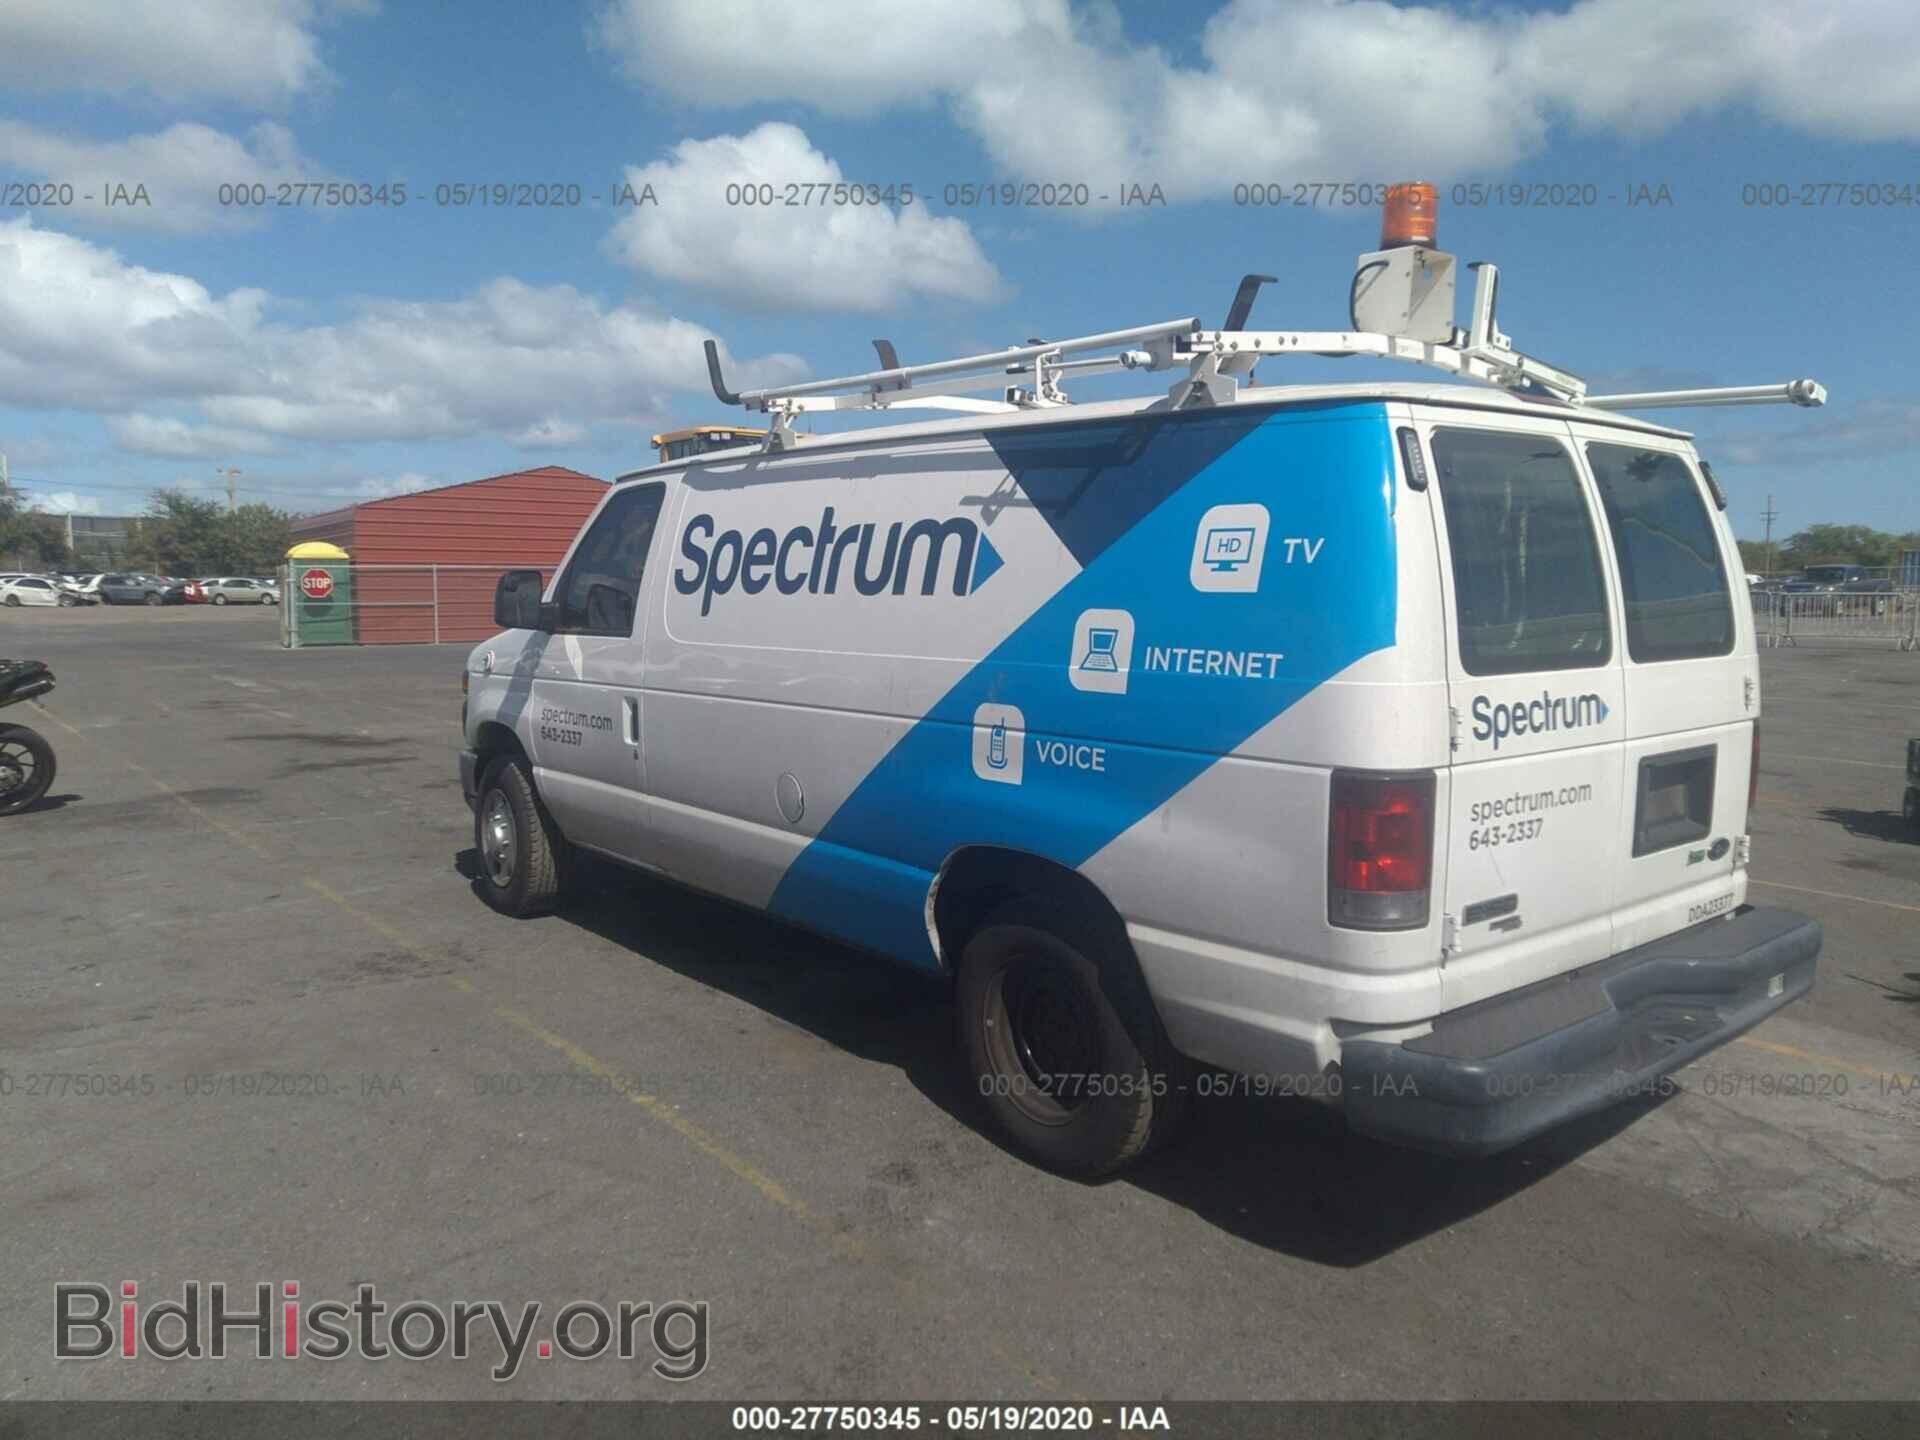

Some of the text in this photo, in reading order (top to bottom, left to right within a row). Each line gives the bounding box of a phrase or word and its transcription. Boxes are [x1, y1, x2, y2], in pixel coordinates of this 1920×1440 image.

[1217, 537, 1242, 553] HD
[1283, 537, 1326, 564] TV
[674, 506, 978, 617] Spectrum
[303, 577, 331, 589] STOP
[1144, 646, 1284, 680] INTERNET
[541, 707, 614, 731] spectrum.com
[1472, 690, 1601, 750] Spectrum
[541, 726, 583, 747] 643-2337
[1035, 740, 1106, 772] VOICE
[1470, 783, 1593, 826] spectrum.com
[1468, 818, 1544, 851] 643-2337
